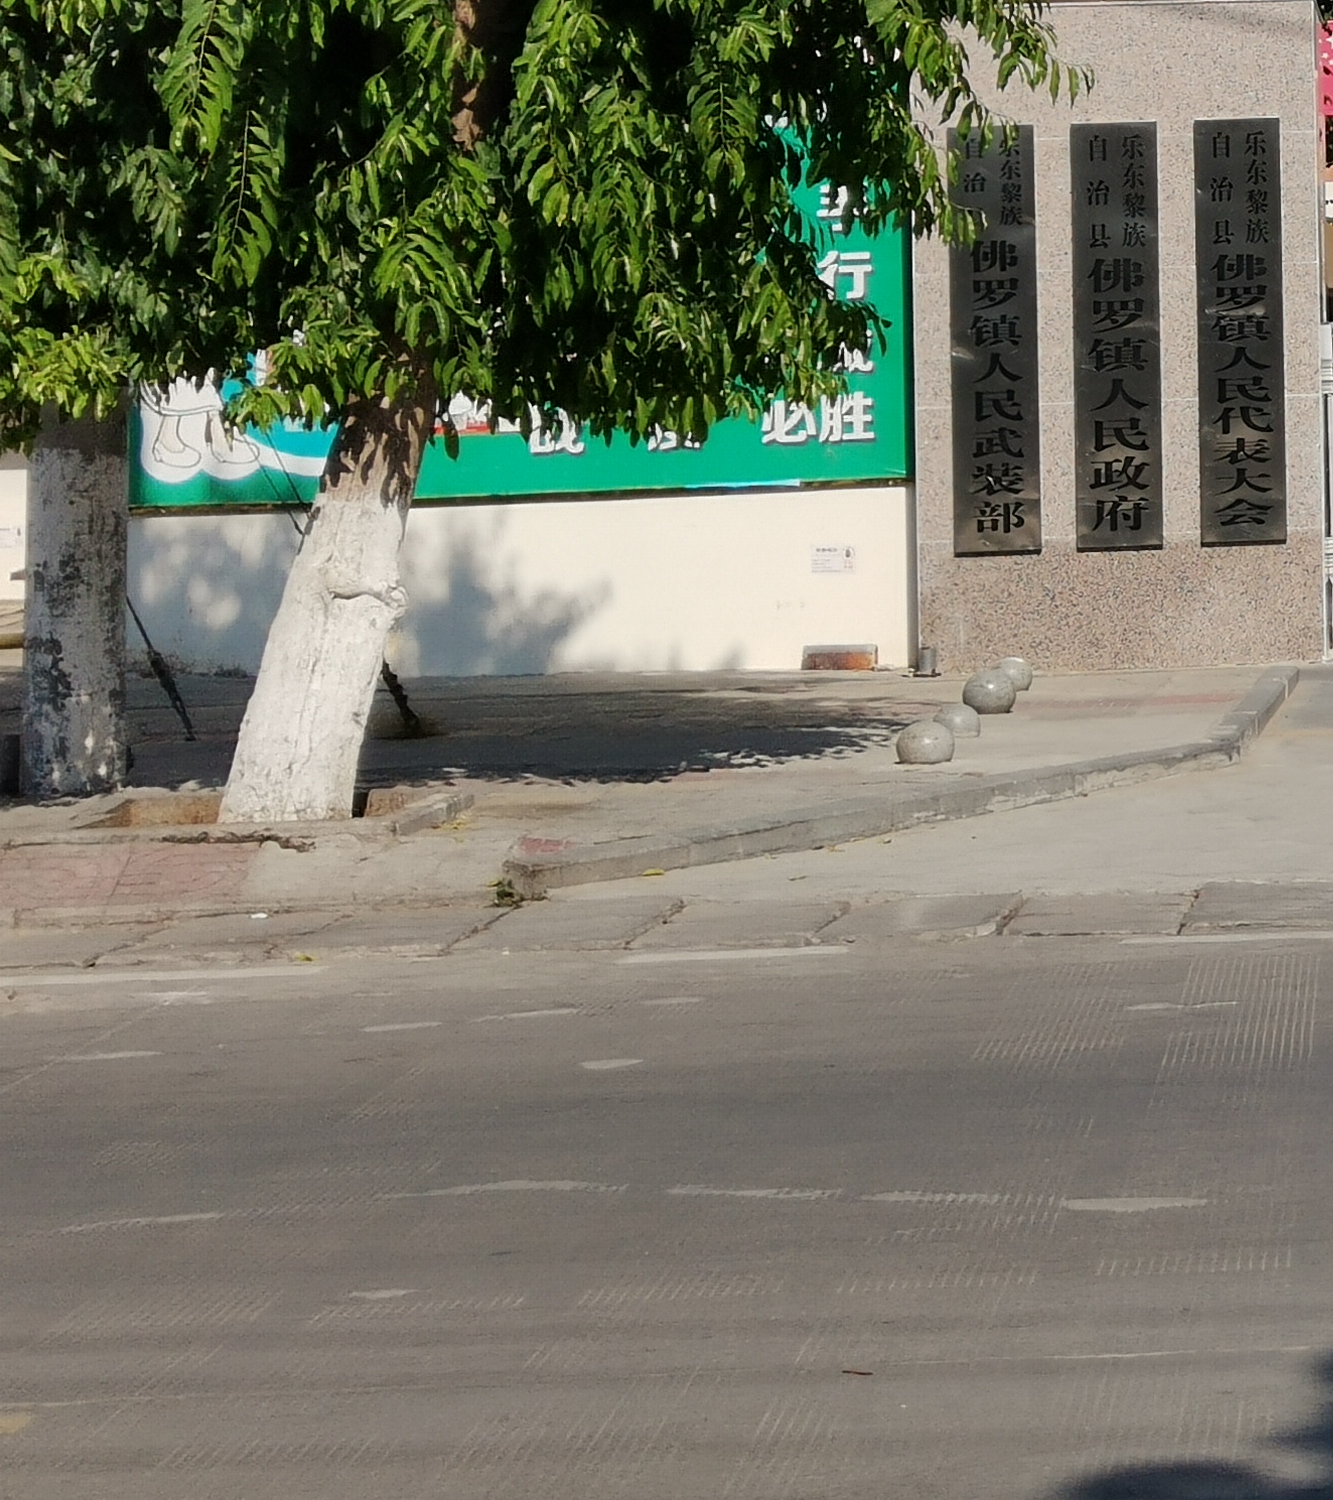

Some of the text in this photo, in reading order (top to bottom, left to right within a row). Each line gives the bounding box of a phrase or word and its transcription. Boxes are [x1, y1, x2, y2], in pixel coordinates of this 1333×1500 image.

[963, 137, 987, 220] 自治
[1086, 134, 1111, 249] 自治县
[1121, 134, 1146, 248] 乐东黎族
[1210, 132, 1235, 245] 自治县
[1244, 131, 1270, 244] 乐东黎族
[762, 391, 875, 443] 必胜
[971, 240, 1025, 534] 佛罗镇人民武装部
[1087, 257, 1150, 532] 佛罗镇人民政府
[1210, 253, 1274, 527] 佛罗镇人民代表大会
